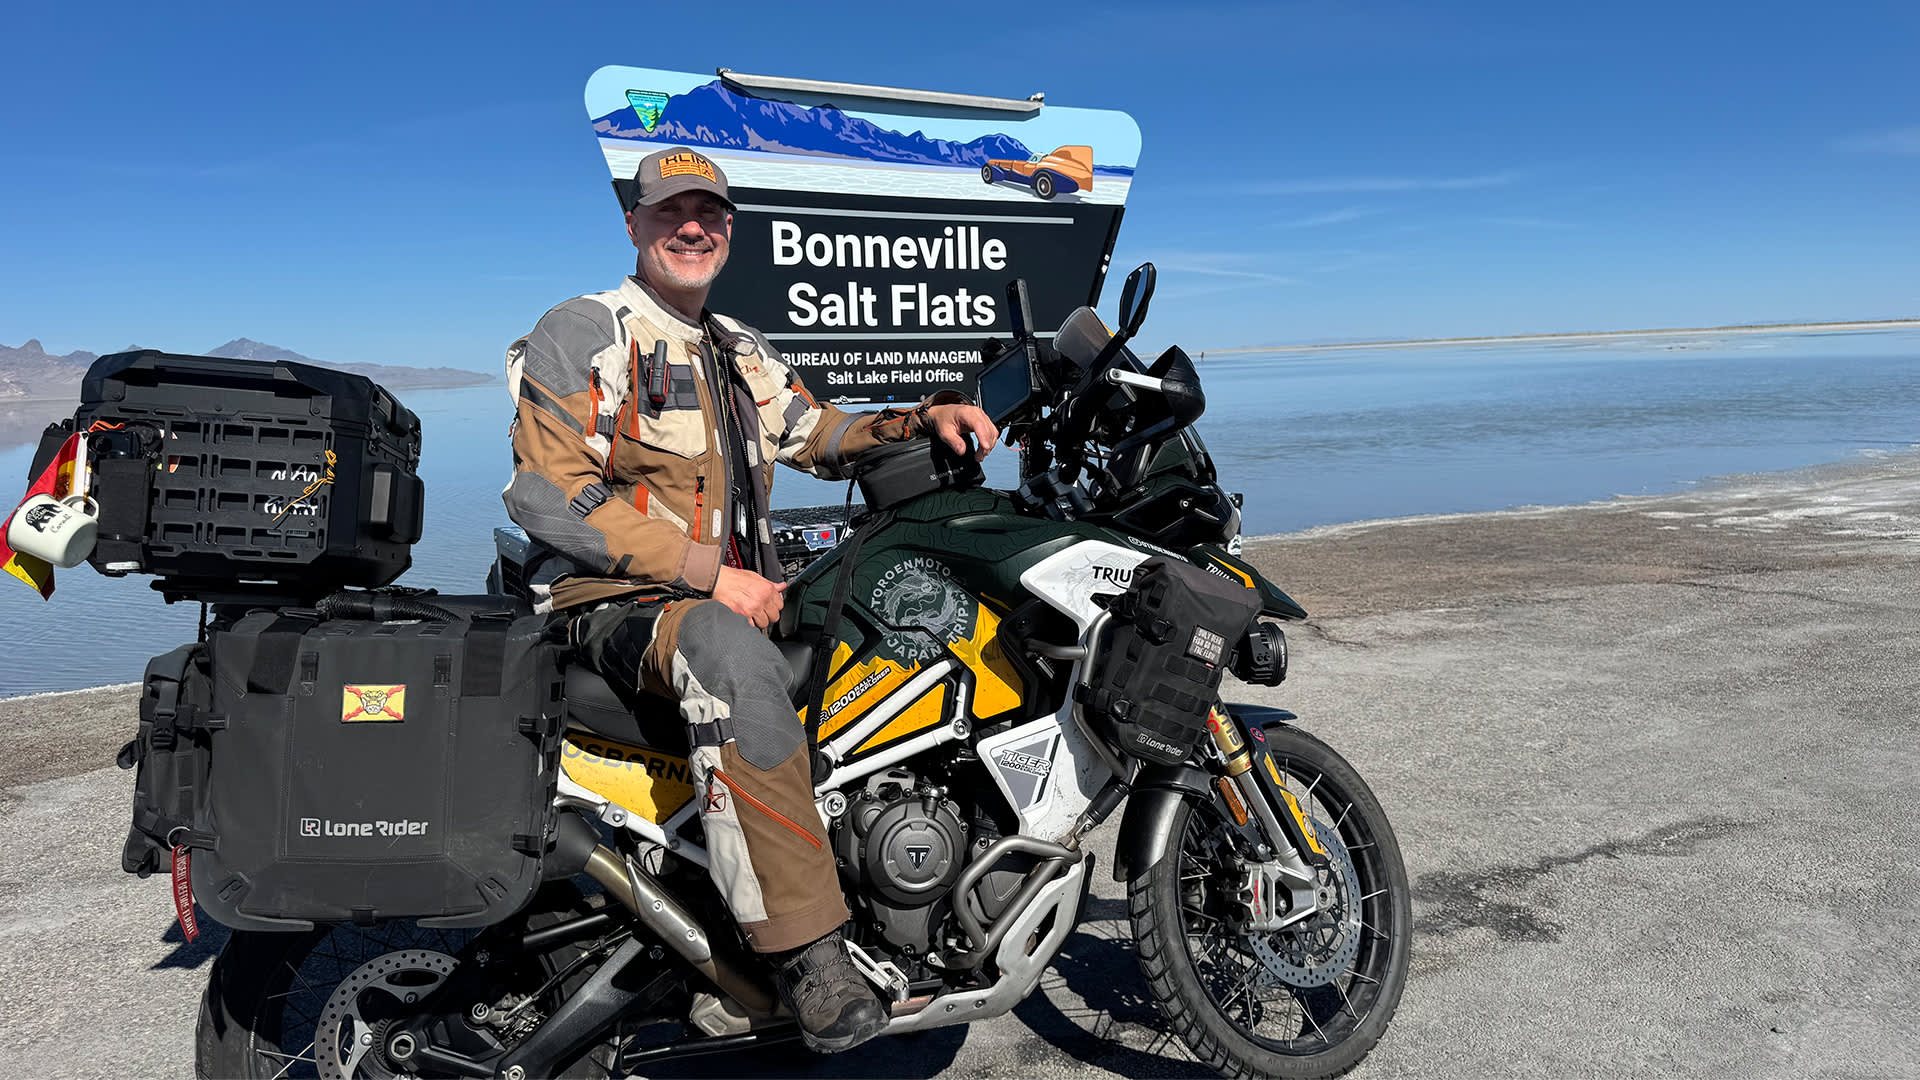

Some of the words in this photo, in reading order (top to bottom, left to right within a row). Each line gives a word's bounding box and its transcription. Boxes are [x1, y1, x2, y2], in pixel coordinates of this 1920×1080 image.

[665, 154, 709, 168] KLIM
[771, 220, 1007, 271] Bonneville
[788, 281, 878, 326] Salt
[891, 282, 996, 326] Flats
[782, 352, 839, 366] BUREAU
[843, 352, 862, 366] OF
[866, 351, 903, 365] LAND
[827, 371, 853, 385] Salt
[857, 371, 888, 384] Lake
[891, 370, 922, 383] Field
[925, 370, 963, 382] Office
[871, 558, 951, 608] TOROENMOTO
[886, 638, 942, 660] JAPAN
[829, 690, 856, 716] 1200
[1001, 760, 1020, 769] 1200
[1002, 750, 1050, 771] TIGER
[325, 820, 373, 836] Lone
[376, 820, 428, 836] Rider
